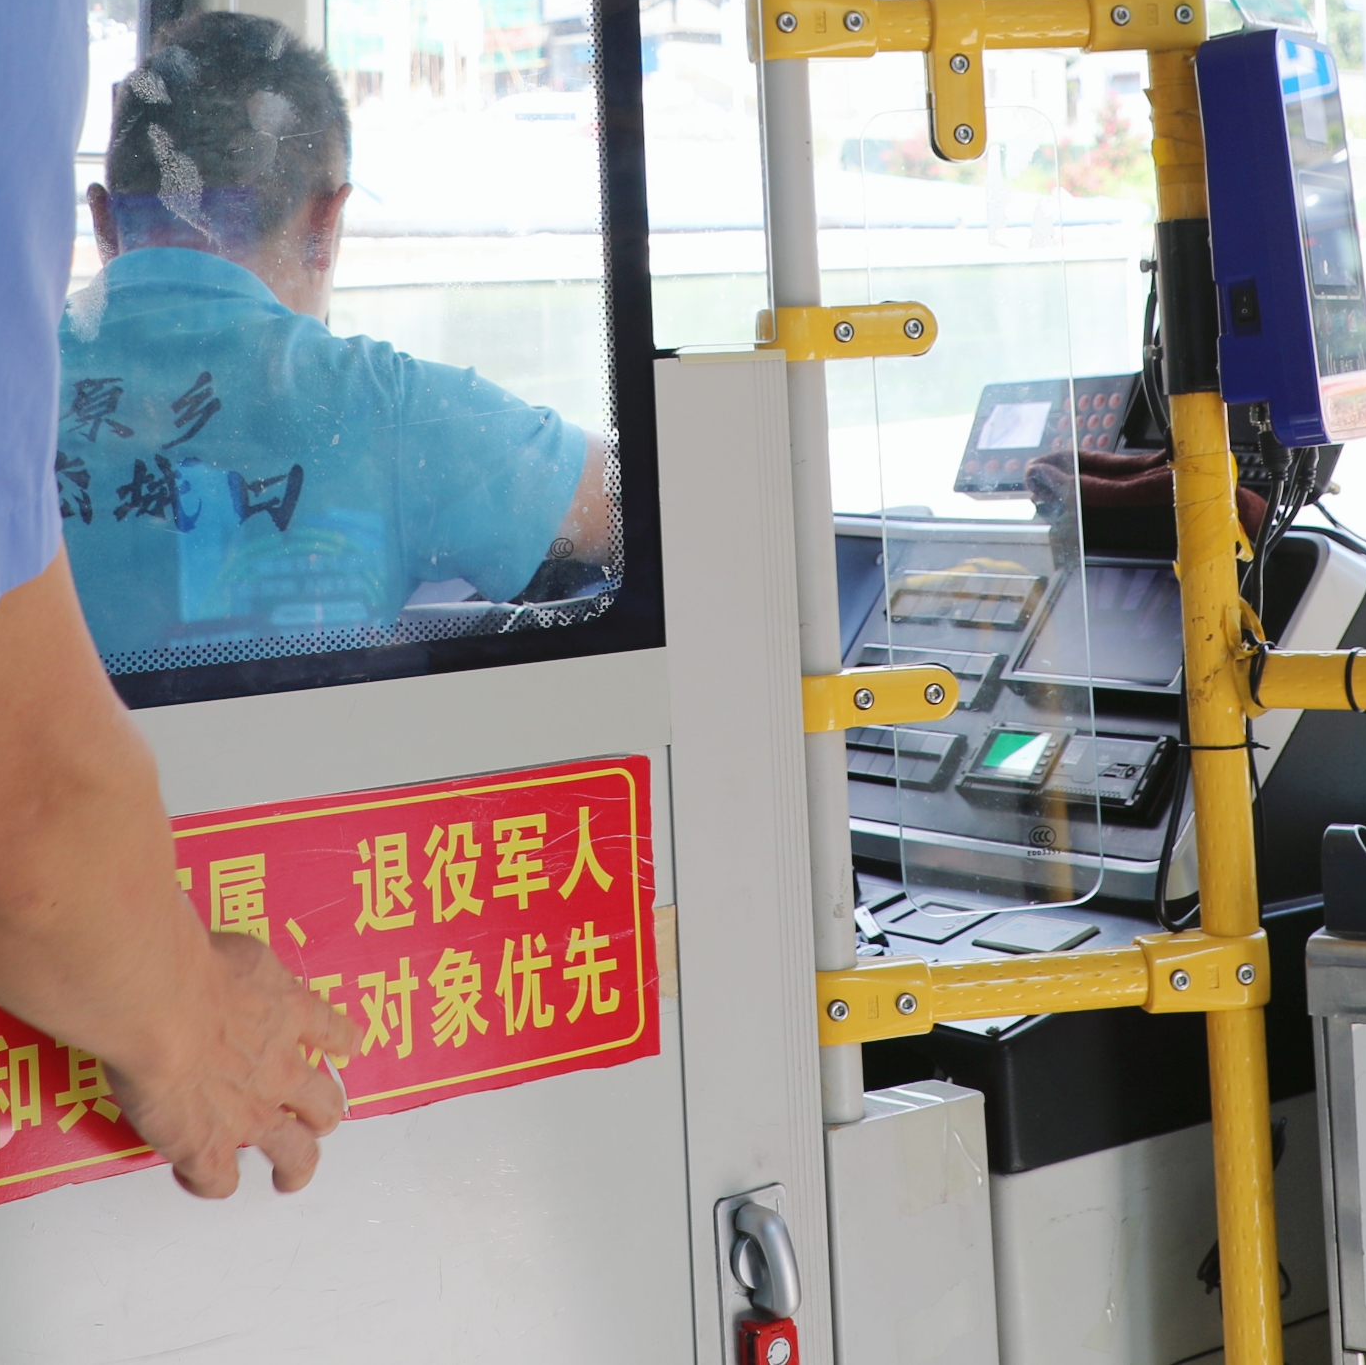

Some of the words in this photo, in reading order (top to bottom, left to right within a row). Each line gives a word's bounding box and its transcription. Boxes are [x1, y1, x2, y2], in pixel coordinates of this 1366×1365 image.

[176, 805, 612, 948] 属、退役军人
